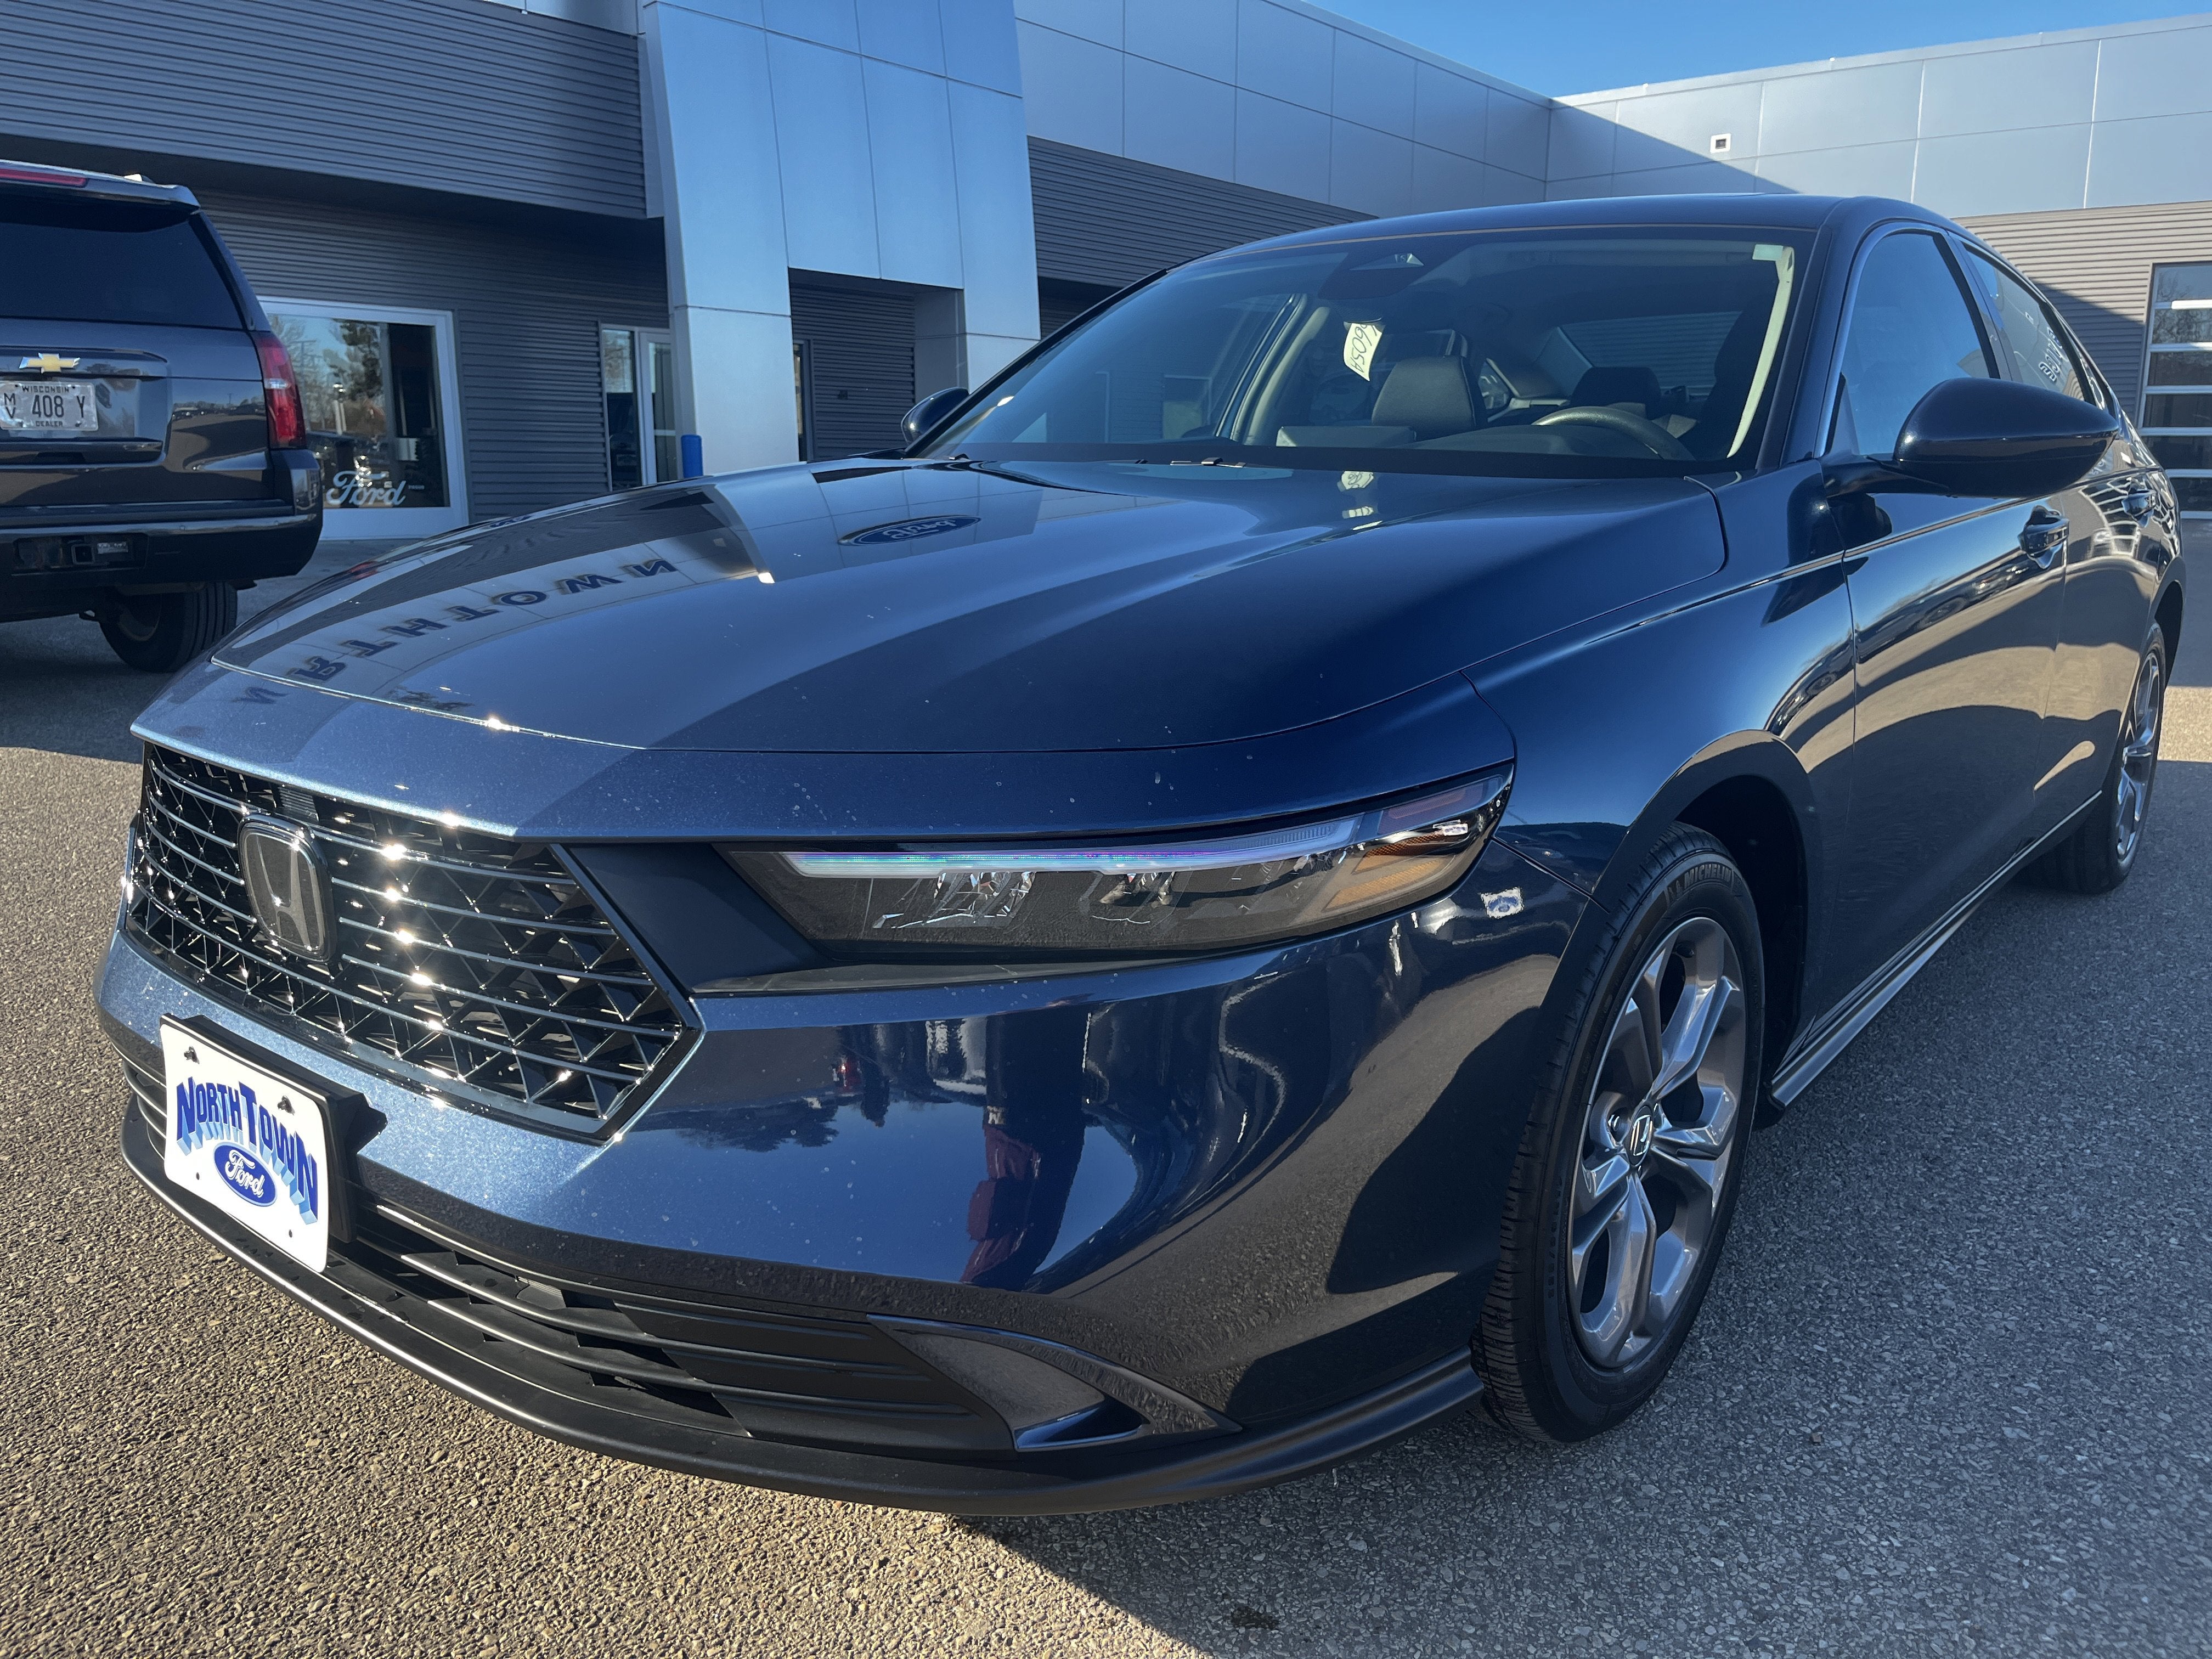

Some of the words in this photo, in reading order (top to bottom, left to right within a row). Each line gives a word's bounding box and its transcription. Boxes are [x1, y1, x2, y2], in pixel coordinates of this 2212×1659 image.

[22, 385, 69, 393] WISCONSIN
[31, 394, 64, 417] 408
[76, 396, 86, 418] Y
[326, 470, 407, 506] Ford
[1684, 863, 1733, 890] MICHELIN
[225, 1149, 264, 1198] Ford
